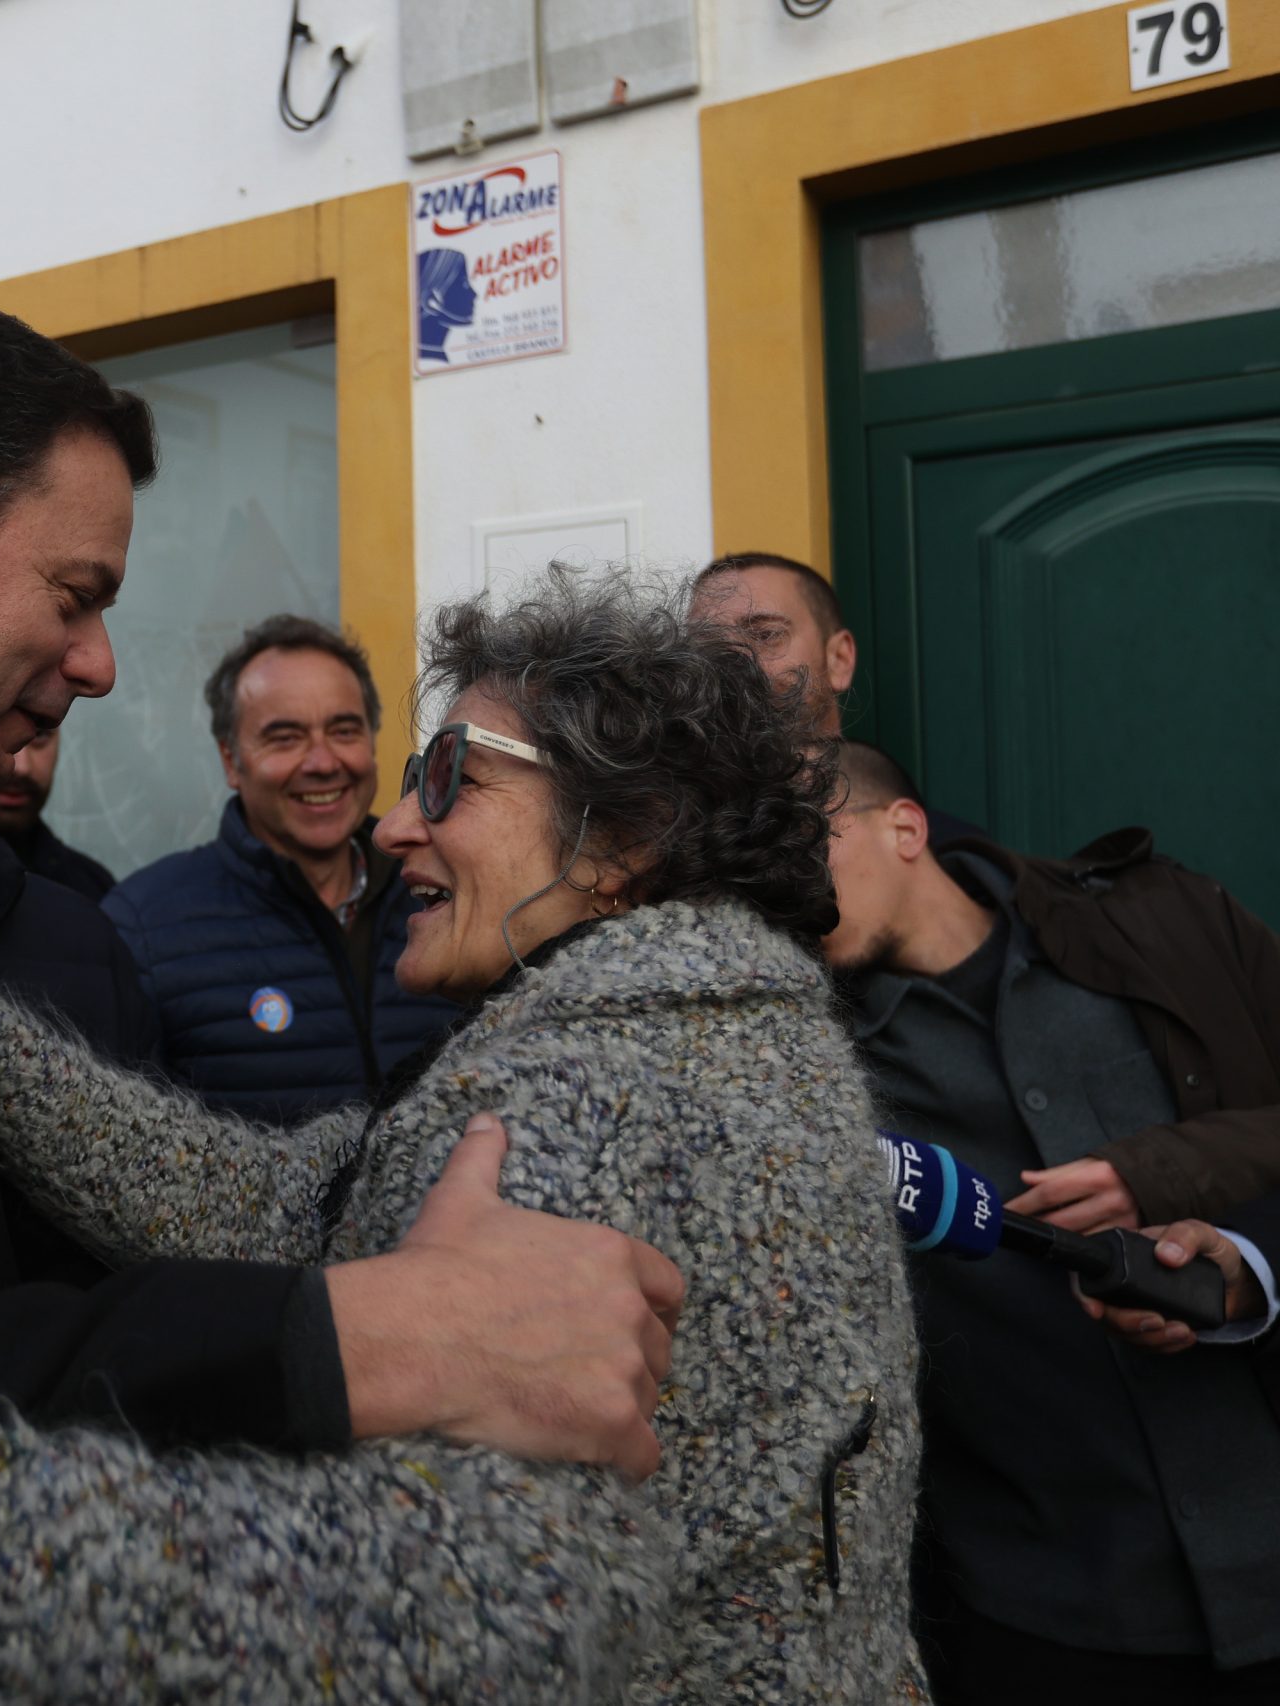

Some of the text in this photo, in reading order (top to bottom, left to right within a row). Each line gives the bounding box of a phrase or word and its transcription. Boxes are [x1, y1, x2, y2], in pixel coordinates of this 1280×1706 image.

[1136, 1, 1221, 76] 79
[472, 230, 556, 280] ALARME
[483, 256, 560, 302] ACTIVO
[480, 734, 509, 748] CONVERSE
[897, 1141, 924, 1213] RTP
[971, 1177, 993, 1231] rtp.pt
